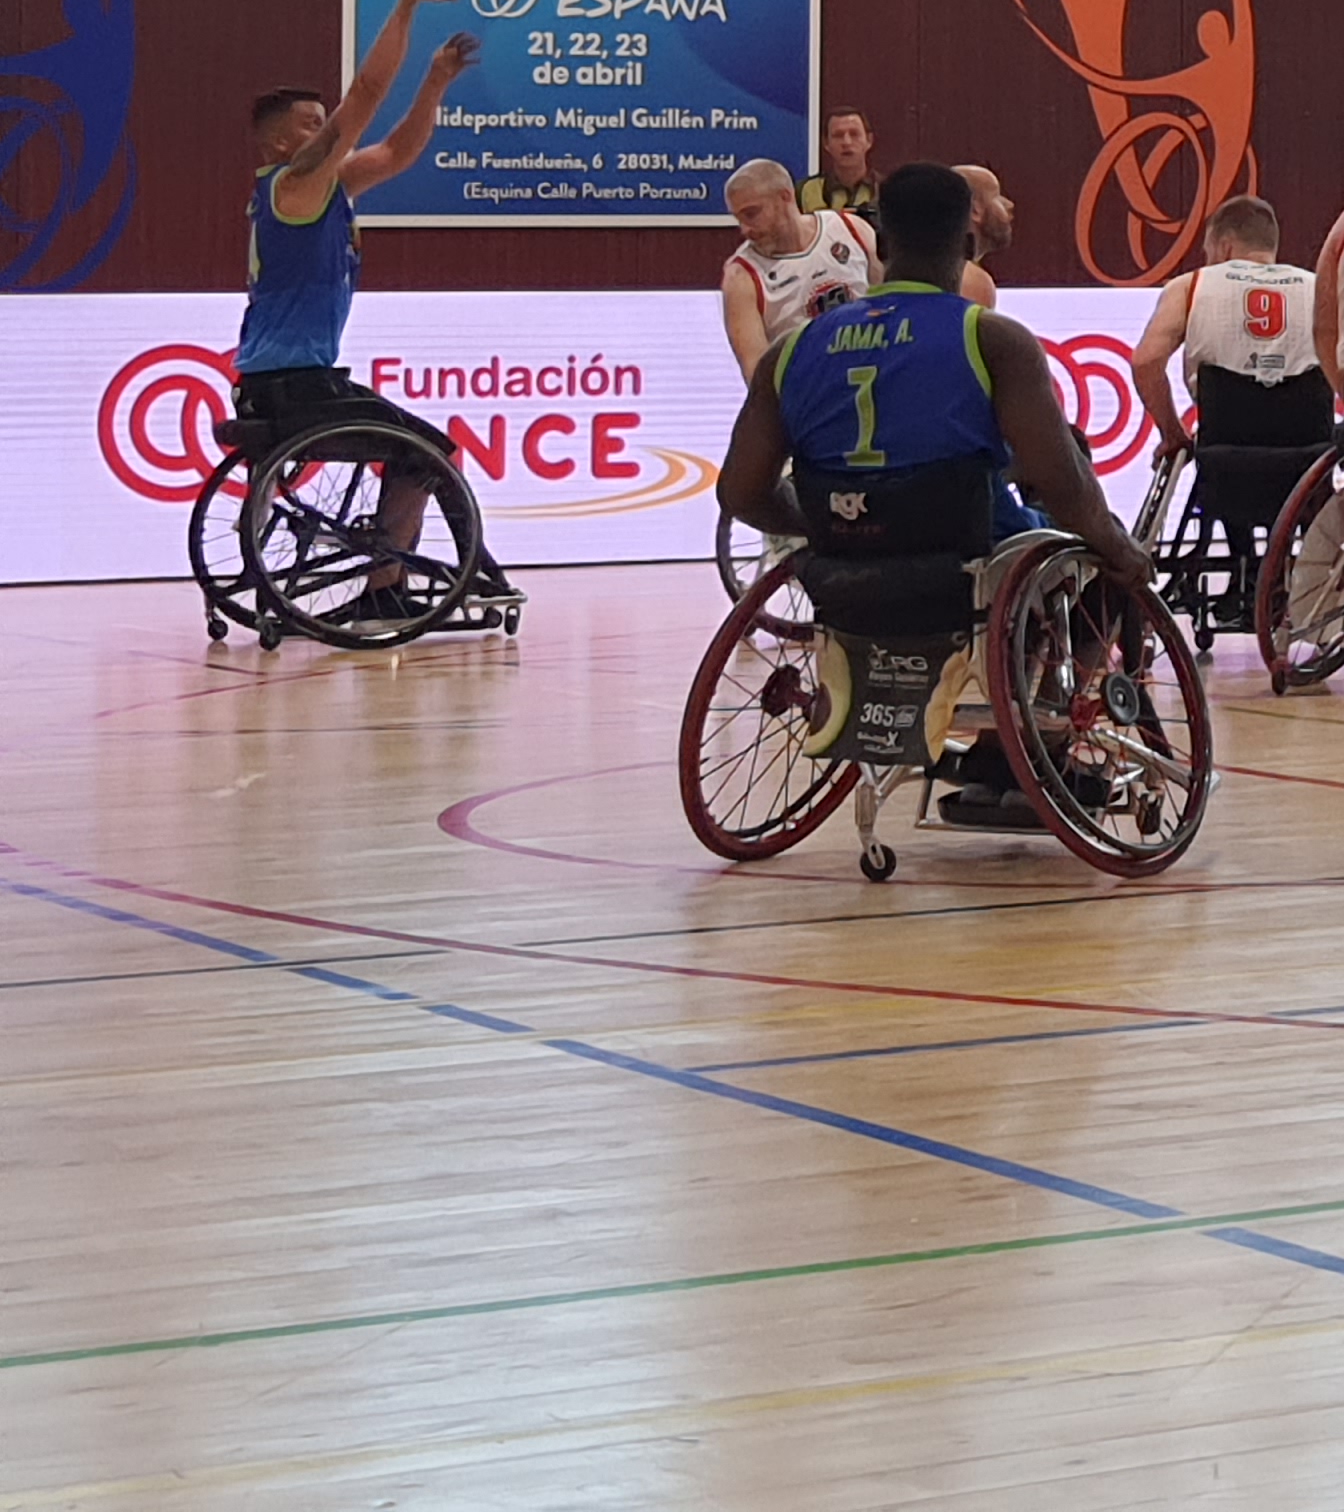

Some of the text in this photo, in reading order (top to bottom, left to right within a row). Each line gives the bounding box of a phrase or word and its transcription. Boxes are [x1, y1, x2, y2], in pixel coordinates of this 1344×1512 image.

[527, 32, 648, 60] 21, 22, 23
[533, 62, 643, 86] de abril
[435, 106, 758, 136] lideportivo Miguel Guillén Prim
[435, 152, 477, 169] Calle
[481, 152, 588, 173] Fuentidueña,
[592, 153, 604, 170] 6
[678, 154, 735, 171] Madrid
[463, 182, 533, 204] (Esquina
[537, 182, 577, 200] Calle
[582, 183, 635, 200] Puerto
[1243, 287, 1287, 341] 9
[371, 353, 642, 399] Fundación
[846, 365, 885, 467] 1
[448, 412, 641, 481] NCE
[860, 702, 895, 728] 365
